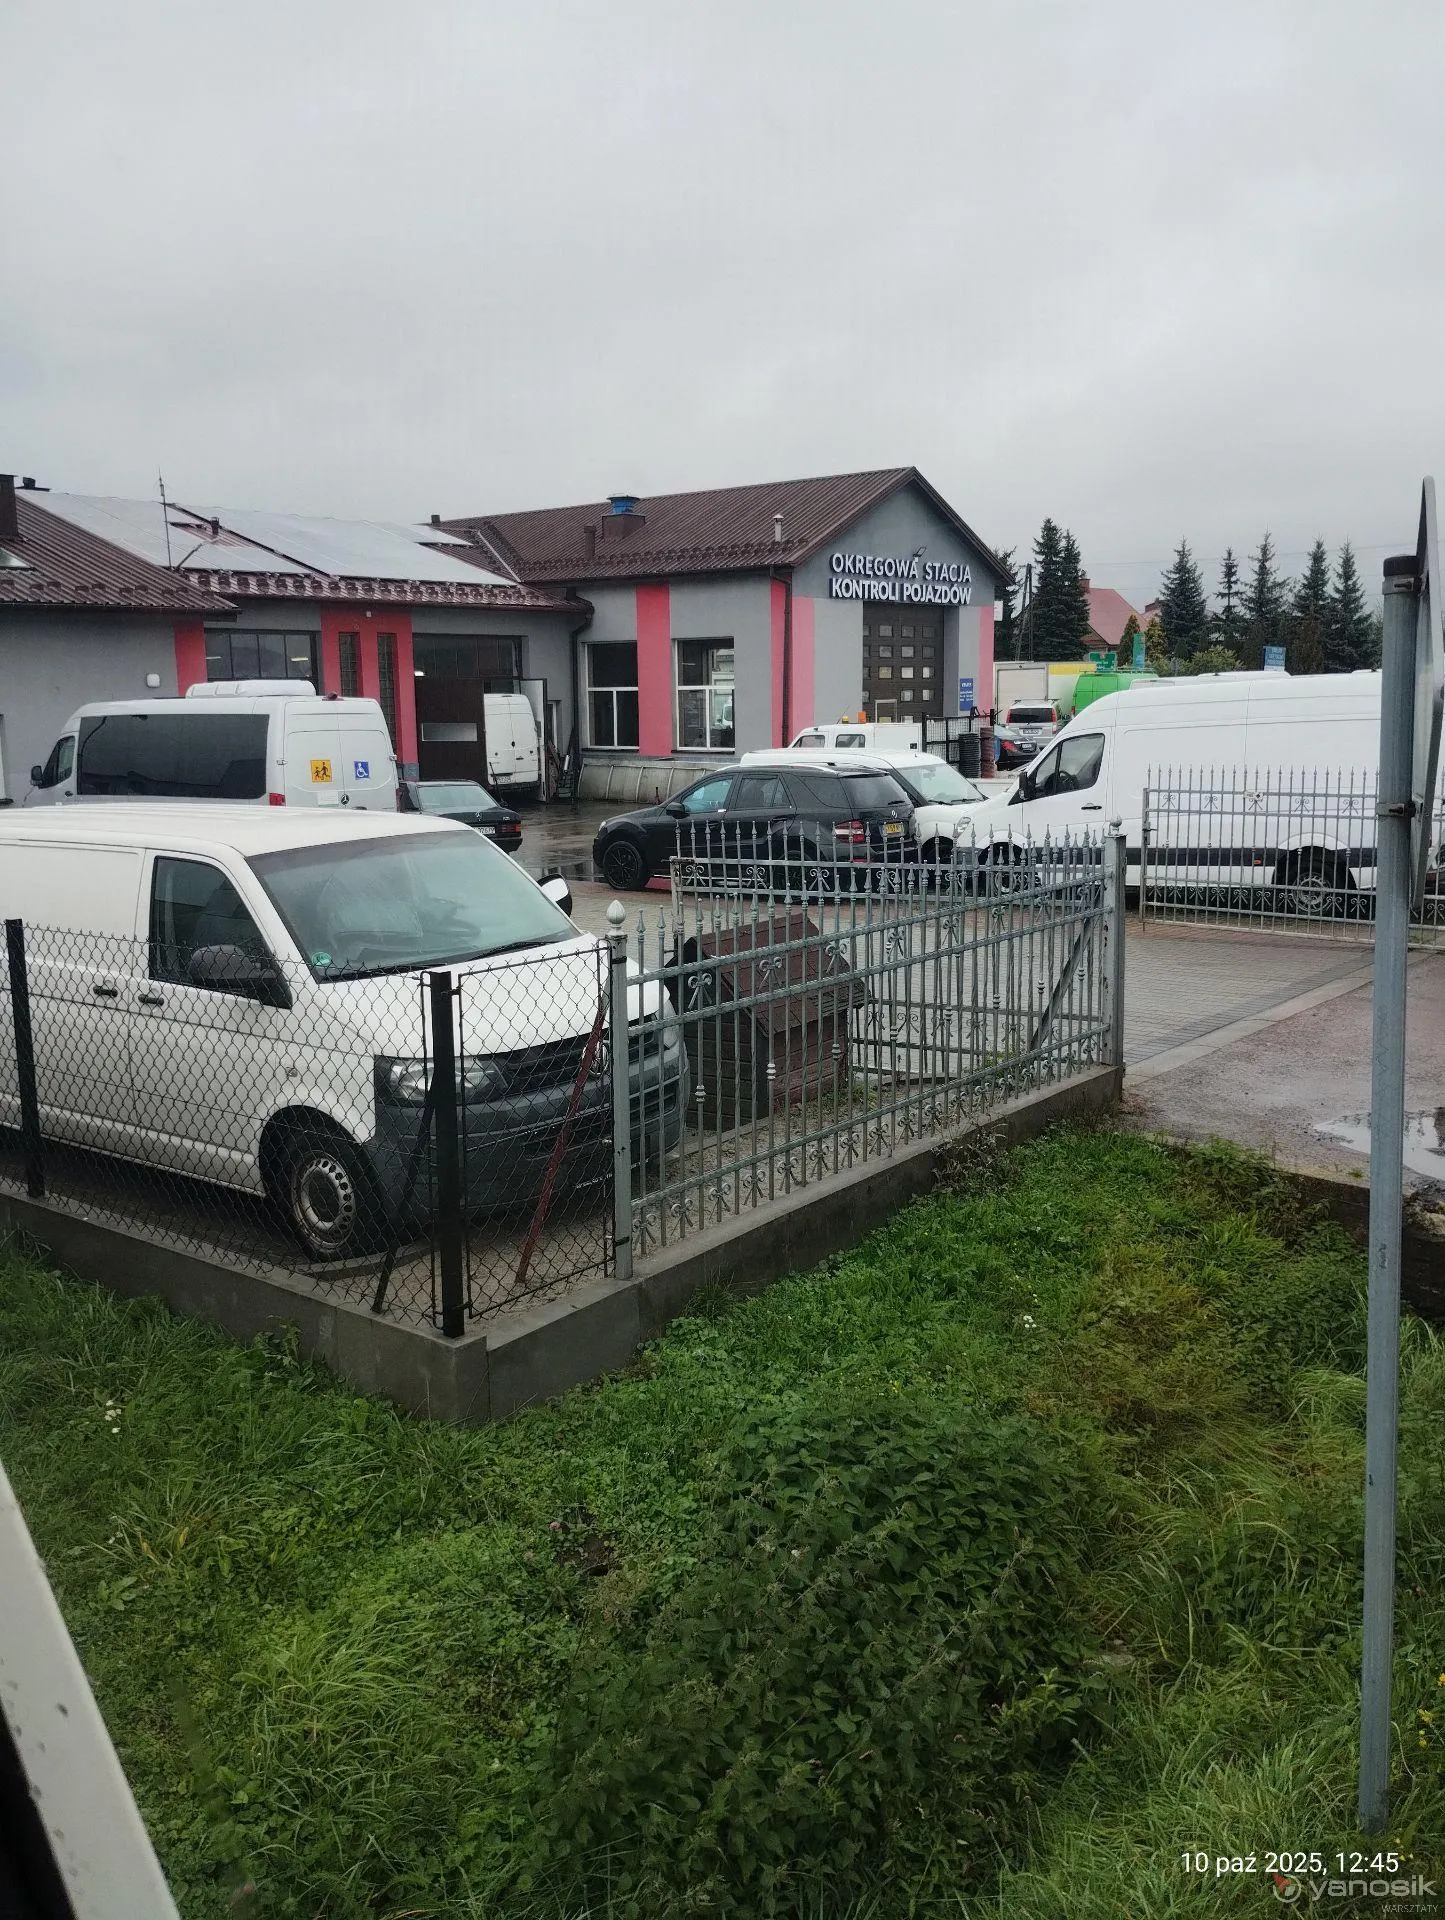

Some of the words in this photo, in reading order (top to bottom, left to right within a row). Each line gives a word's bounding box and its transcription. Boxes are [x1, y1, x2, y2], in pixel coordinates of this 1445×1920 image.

[832, 553, 919, 578] OKRĘGOWA
[925, 562, 972, 583] STACJA
[832, 577, 899, 601] KONTROLI
[903, 583, 972, 605] POJAZDÓW
